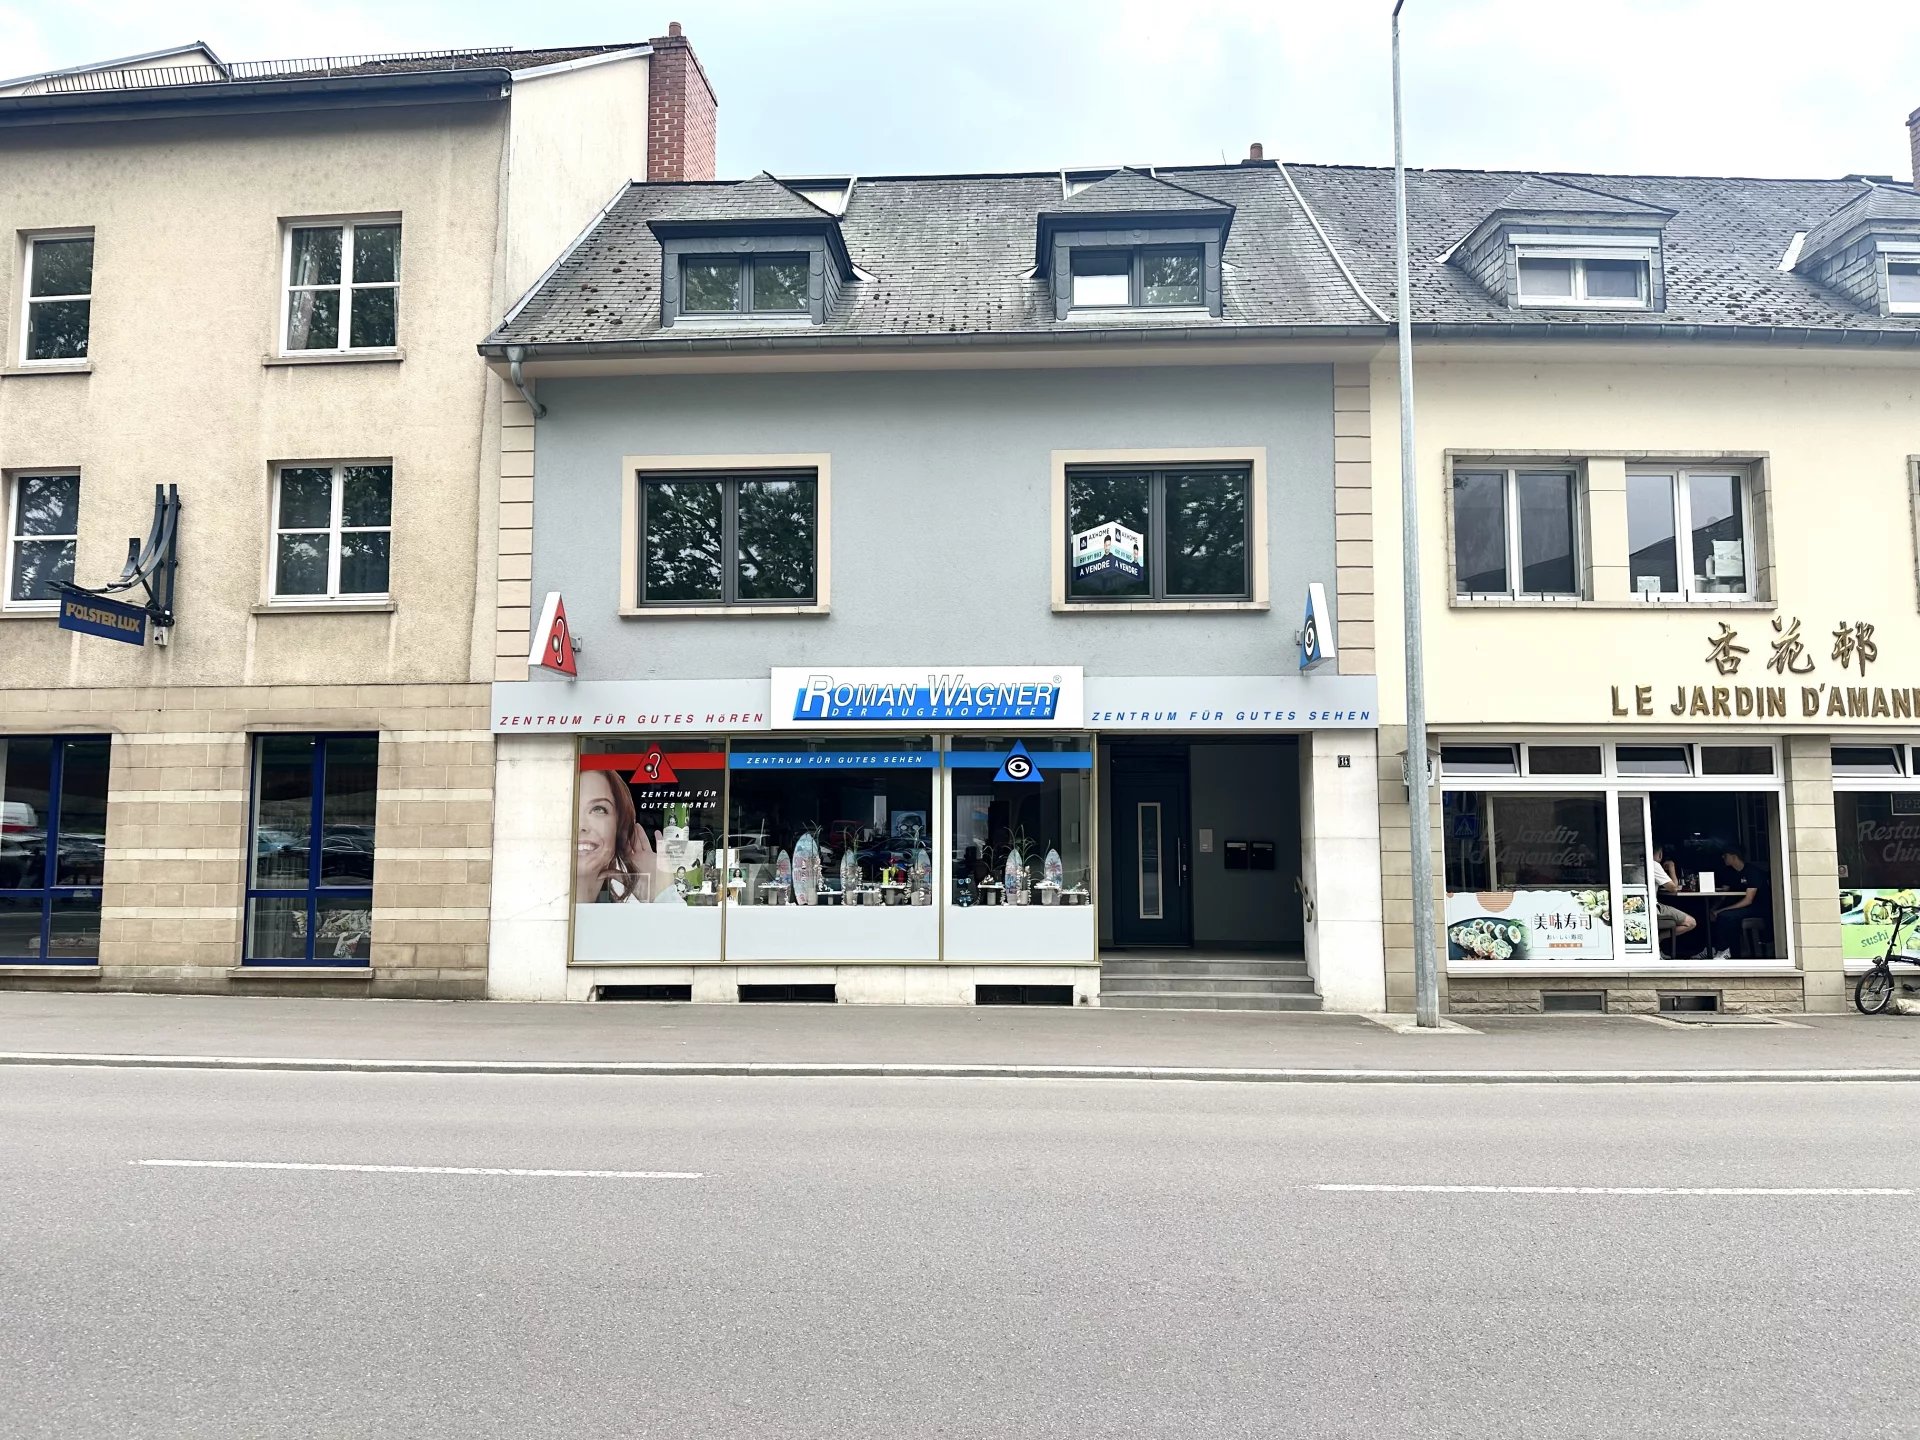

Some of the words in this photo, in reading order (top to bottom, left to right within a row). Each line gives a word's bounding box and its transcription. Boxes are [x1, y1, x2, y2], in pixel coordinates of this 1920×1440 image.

[1085, 560, 1110, 574] VENDRE
[1119, 564, 1138, 576] VENDRE
[65, 602, 117, 628] POLSTER
[117, 614, 141, 633] LUX
[801, 674, 919, 719] ROMAN
[1611, 684, 1654, 717] LE
[1670, 685, 1787, 718] JARDIN
[830, 707, 868, 718] DER
[885, 706, 1052, 718] AUGENOPTIKER
[1091, 711, 1178, 722] ZENTRUM
[1189, 708, 1224, 721] FÜR
[1235, 710, 1297, 721] GUTES
[1308, 710, 1371, 721] SEHEN
[499, 715, 583, 727] ZENTRUM
[593, 712, 627, 725] FÜR
[637, 713, 695, 725] GUTES
[746, 756, 802, 765] ZENTRUM
[808, 754, 832, 765] FÜR
[838, 756, 877, 764] GUTES
[883, 756, 923, 764] SEHEN
[640, 790, 691, 799] ZENTRUM
[696, 789, 718, 798] FÜR
[640, 801, 675, 809] GUTES
[1533, 912, 1593, 931] 美味寿司
[1860, 929, 1889, 948] sushi
